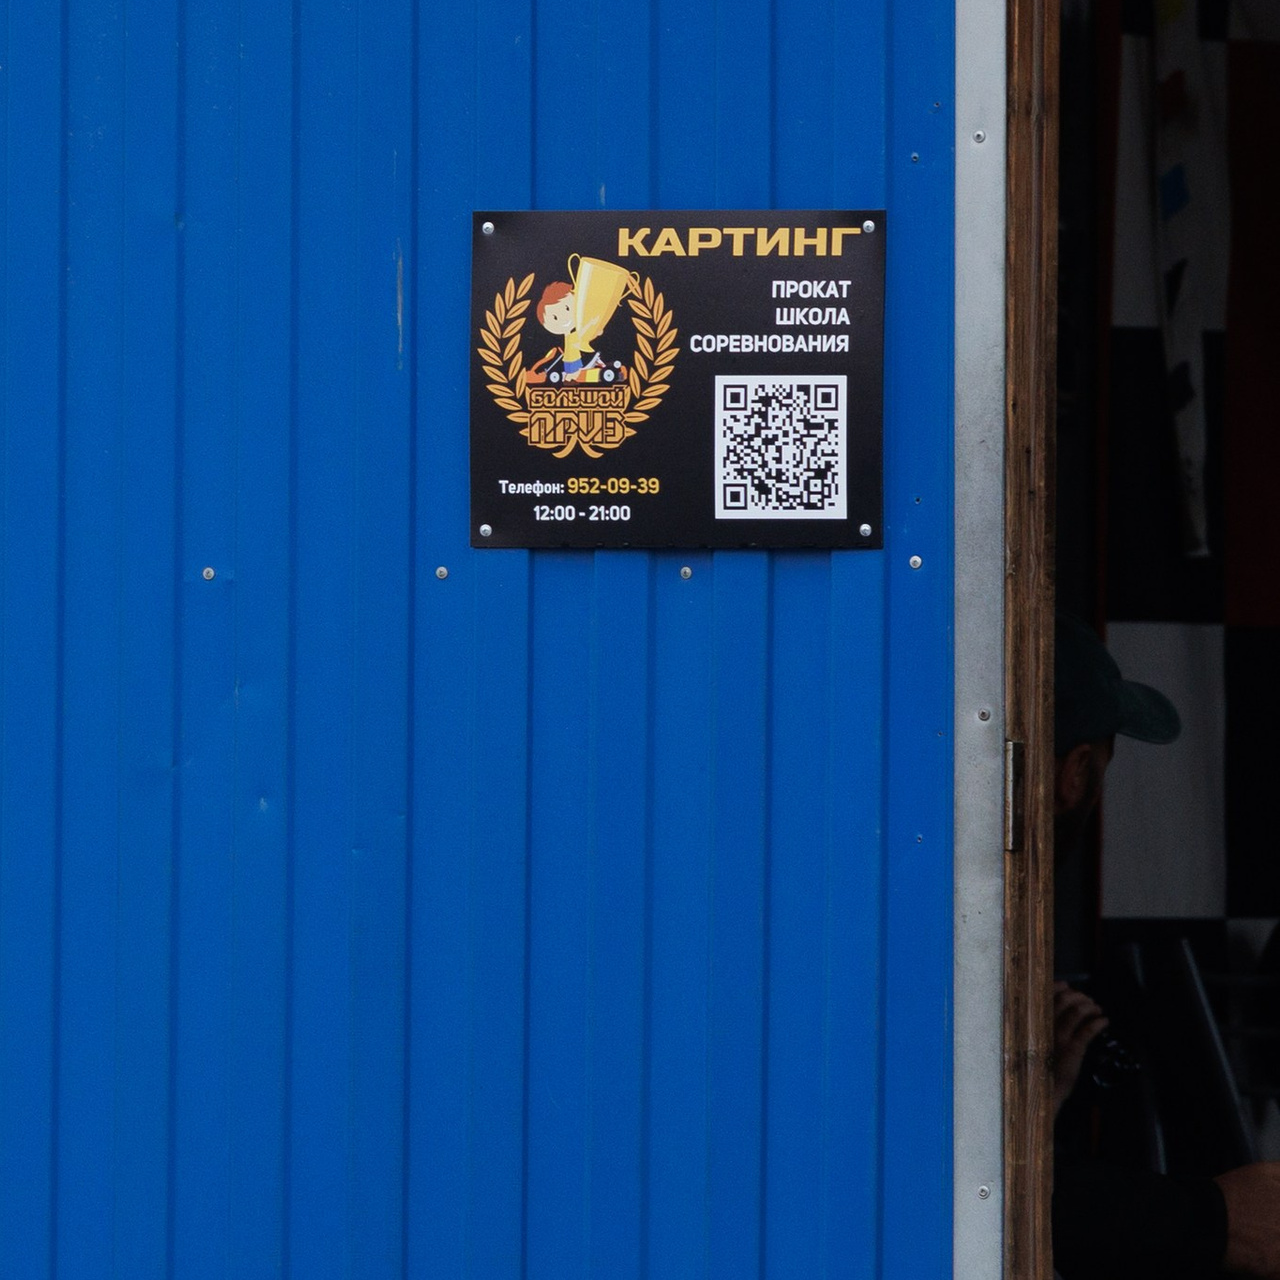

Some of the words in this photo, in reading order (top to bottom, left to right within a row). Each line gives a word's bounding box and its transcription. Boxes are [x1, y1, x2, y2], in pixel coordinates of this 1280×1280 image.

[618, 227, 861, 257] КАРТИНГ
[772, 280, 852, 298] ПРОКАТ
[775, 307, 851, 326] ШКОЛА
[690, 334, 849, 353] СОРЕВНОВАНИЯ
[529, 385, 625, 408] БОЛЬШОЙ
[529, 410, 625, 444] ПРИЗ
[498, 480, 565, 497] Телефон:
[567, 477, 660, 494] 952-09-39
[533, 505, 576, 521] 12:00
[588, 505, 631, 521] 21:00
